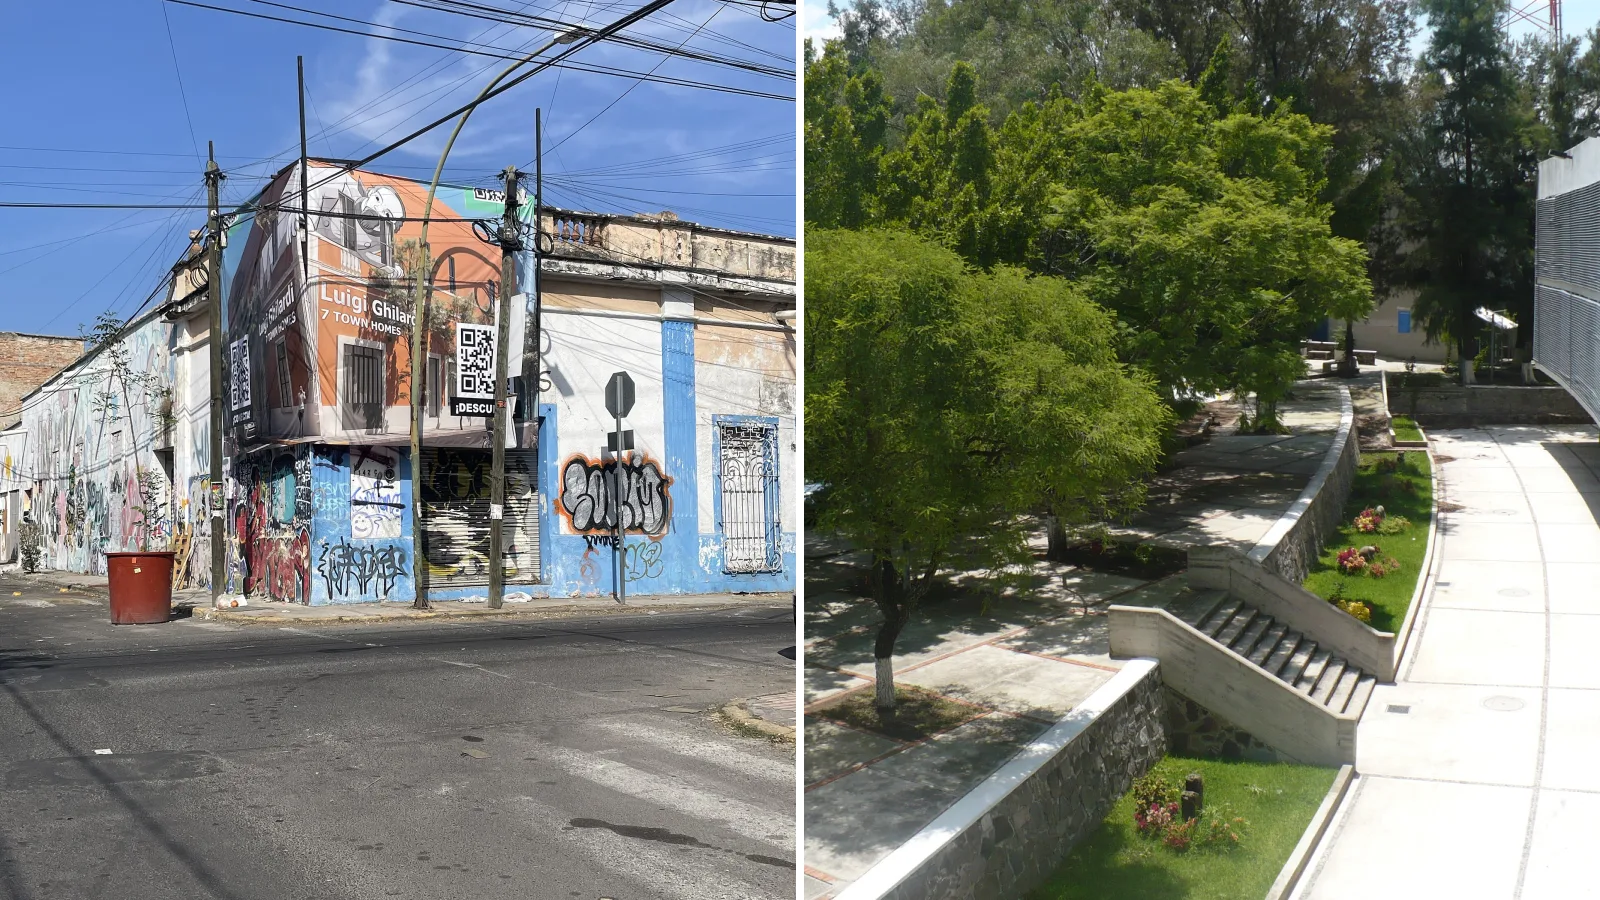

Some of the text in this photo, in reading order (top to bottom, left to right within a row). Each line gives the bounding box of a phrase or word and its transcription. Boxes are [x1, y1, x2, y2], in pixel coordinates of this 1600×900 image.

[321, 281, 416, 326] Luigi Ghilar
[321, 308, 401, 336] 7 TOWN HOMES
[455, 402, 493, 415] ¡DESCU
